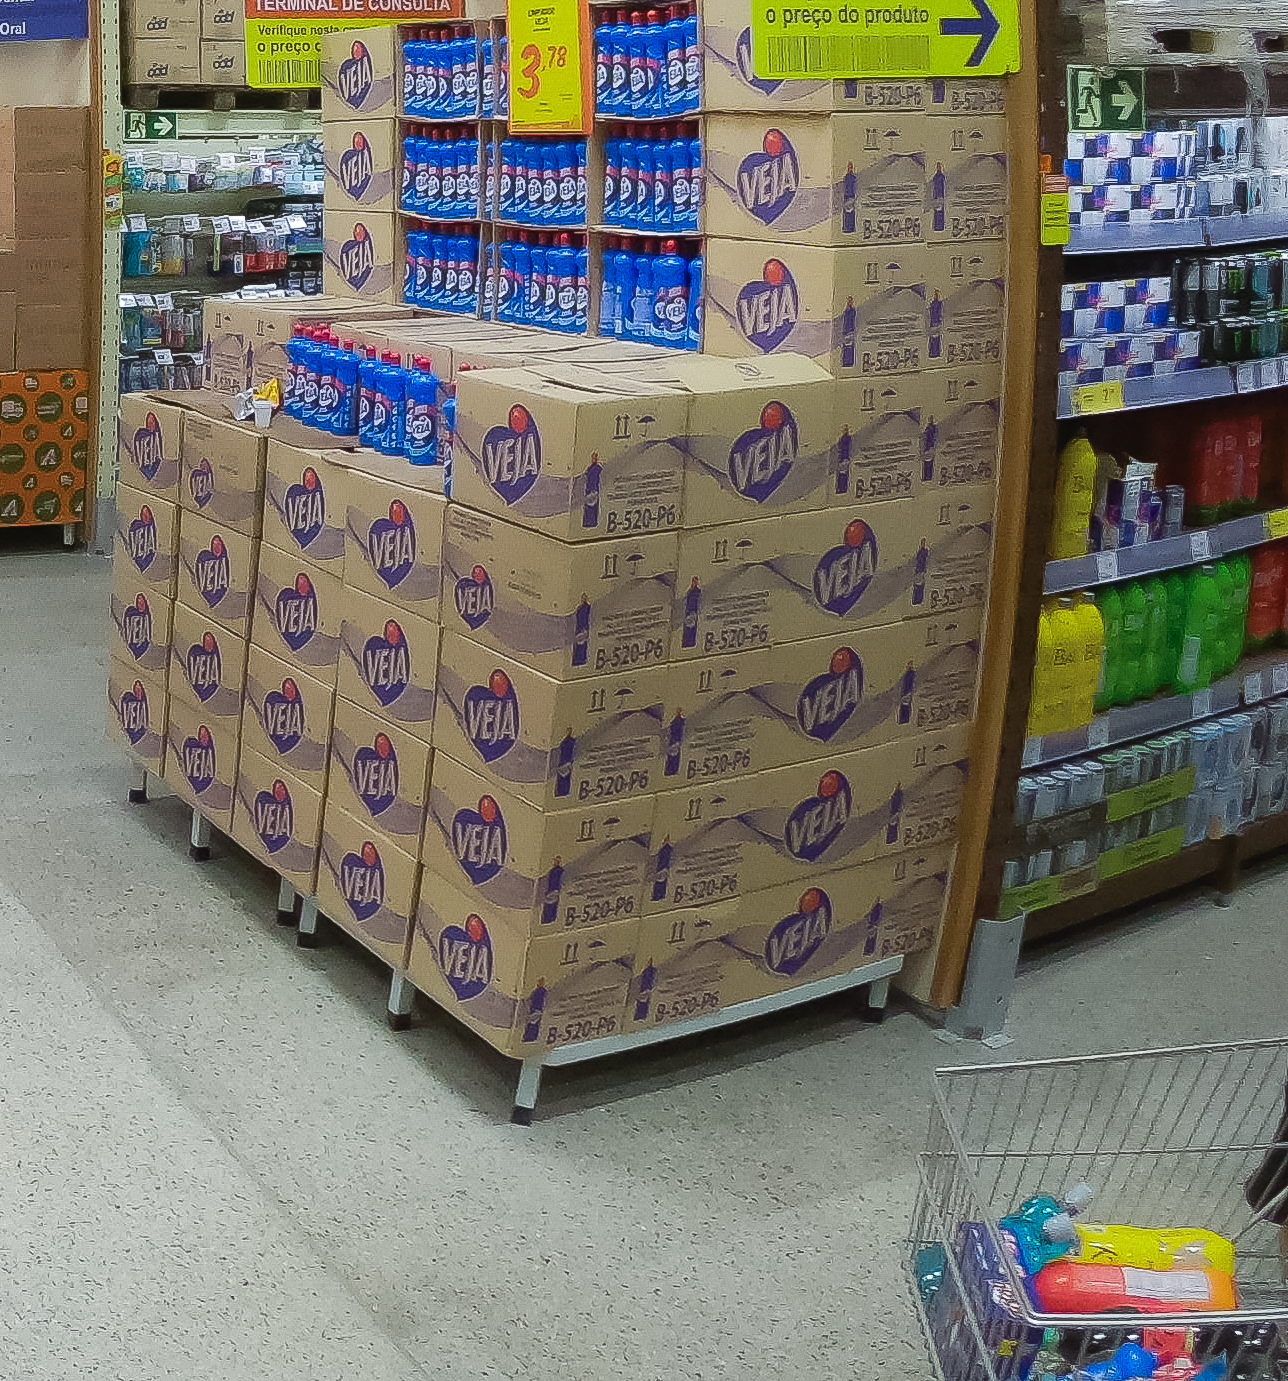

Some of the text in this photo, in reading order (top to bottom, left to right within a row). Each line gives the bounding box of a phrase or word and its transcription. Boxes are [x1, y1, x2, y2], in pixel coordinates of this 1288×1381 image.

[0, 22, 27, 35] Oral
[257, 24, 308, 37] Verifique
[766, 5, 930, 29] o preço do produto
[257, 41, 311, 56] o preço
[517, 43, 568, 99] 3,78
[484, 434, 541, 485] VEJA
[730, 421, 799, 491] VEJA
[286, 491, 326, 529] VEJA
[607, 505, 681, 534] B-520-P6
[369, 531, 416, 568] VEJA
[196, 560, 230, 590] VEJA
[814, 540, 878, 606] VEJA
[277, 598, 318, 633] VEJA
[457, 585, 493, 616] VEJA
[188, 656, 222, 686] VEJA
[364, 649, 410, 684] VEJA
[264, 705, 304, 737] VEJA
[464, 701, 520, 743] VEJA
[183, 751, 216, 781] VEJA
[355, 764, 400, 800] VEJA
[255, 805, 294, 837] VEJA
[786, 795, 851, 854] VEJA
[453, 825, 508, 871] VEJA
[341, 871, 385, 903] VEJA
[767, 914, 826, 966] VEJA
[439, 945, 493, 987] VEJA
